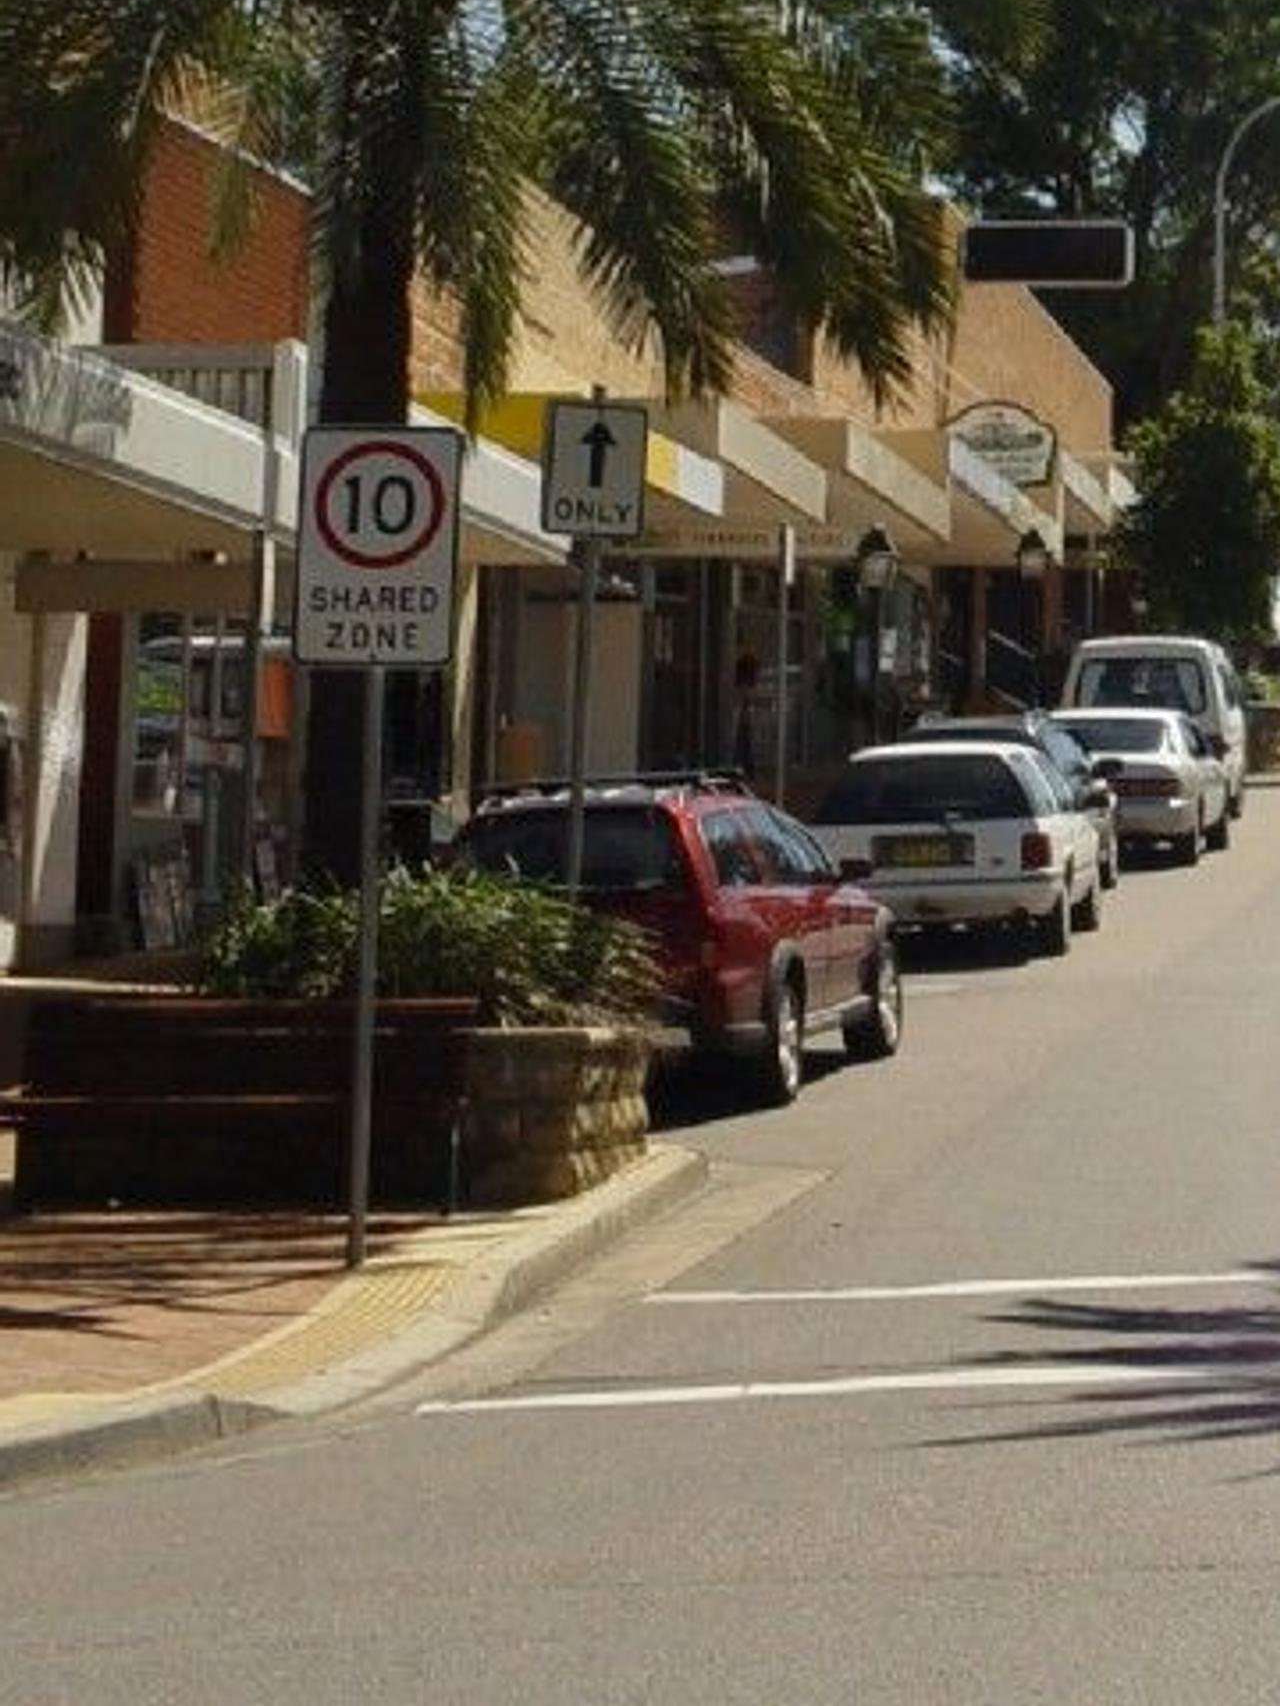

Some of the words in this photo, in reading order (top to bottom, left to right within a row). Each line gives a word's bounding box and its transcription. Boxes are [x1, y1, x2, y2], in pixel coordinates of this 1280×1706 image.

[344, 475, 415, 535] 10
[555, 497, 633, 524] ONLY
[309, 586, 440, 613] SHARED
[325, 622, 419, 649] ZONE
